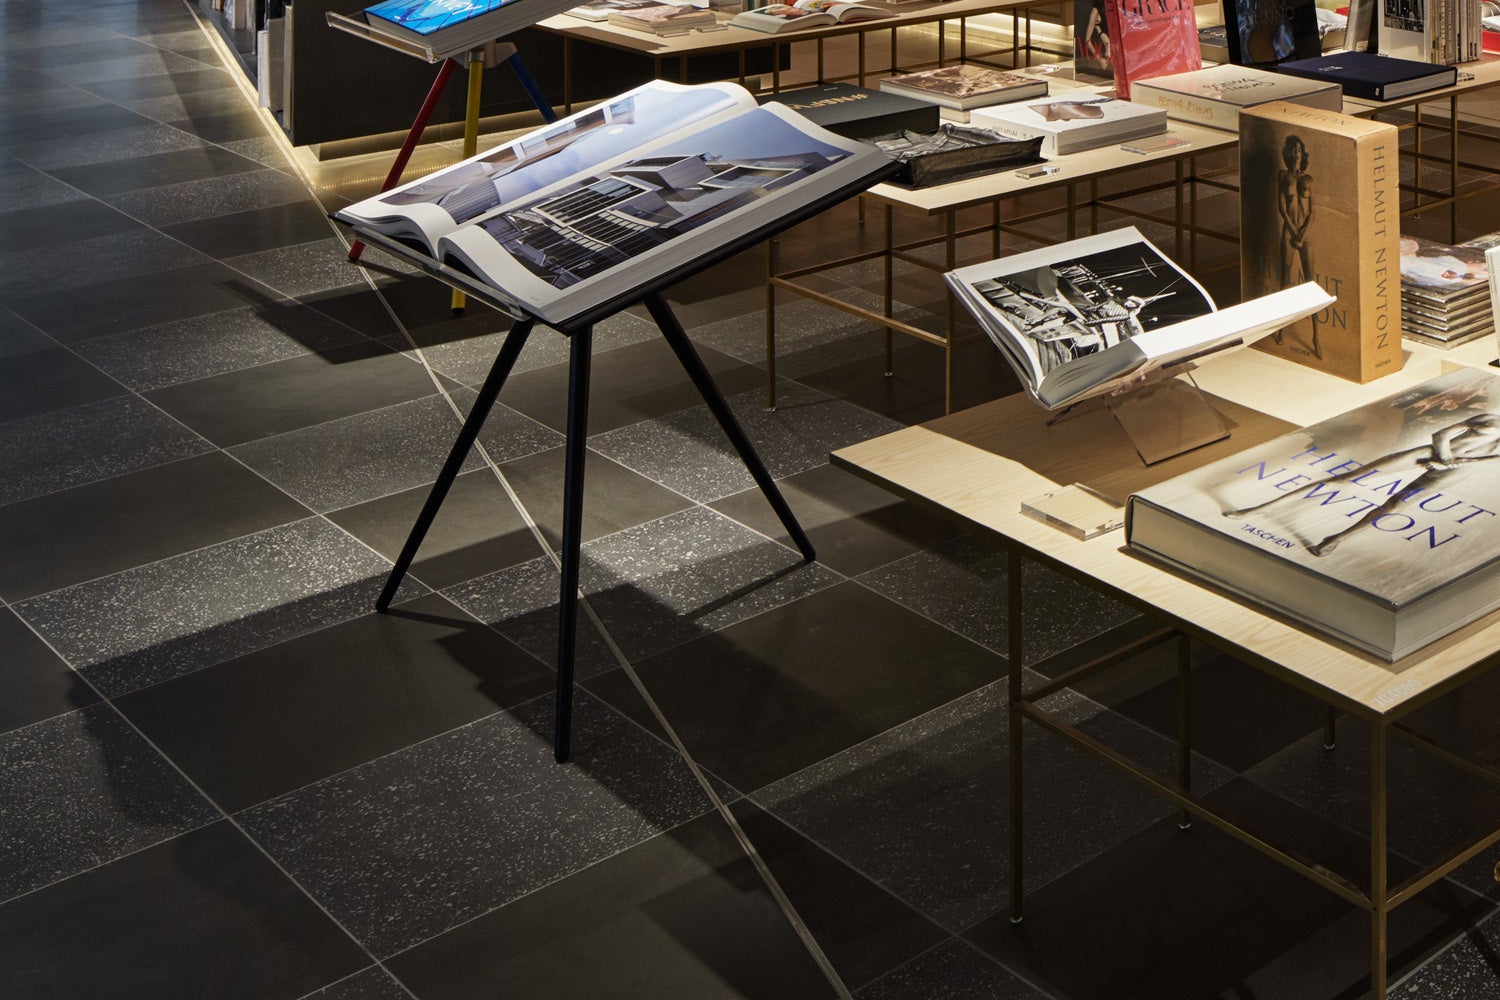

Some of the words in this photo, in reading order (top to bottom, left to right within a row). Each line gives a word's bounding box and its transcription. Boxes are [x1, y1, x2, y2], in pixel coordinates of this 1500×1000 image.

[1373, 145, 1386, 239] HELMUT
[1374, 248, 1389, 351] NEWTON
[1237, 458, 1464, 553] NEWTON
[1290, 446, 1498, 526] HELMUT
[1240, 523, 1296, 550] TASCHEN
